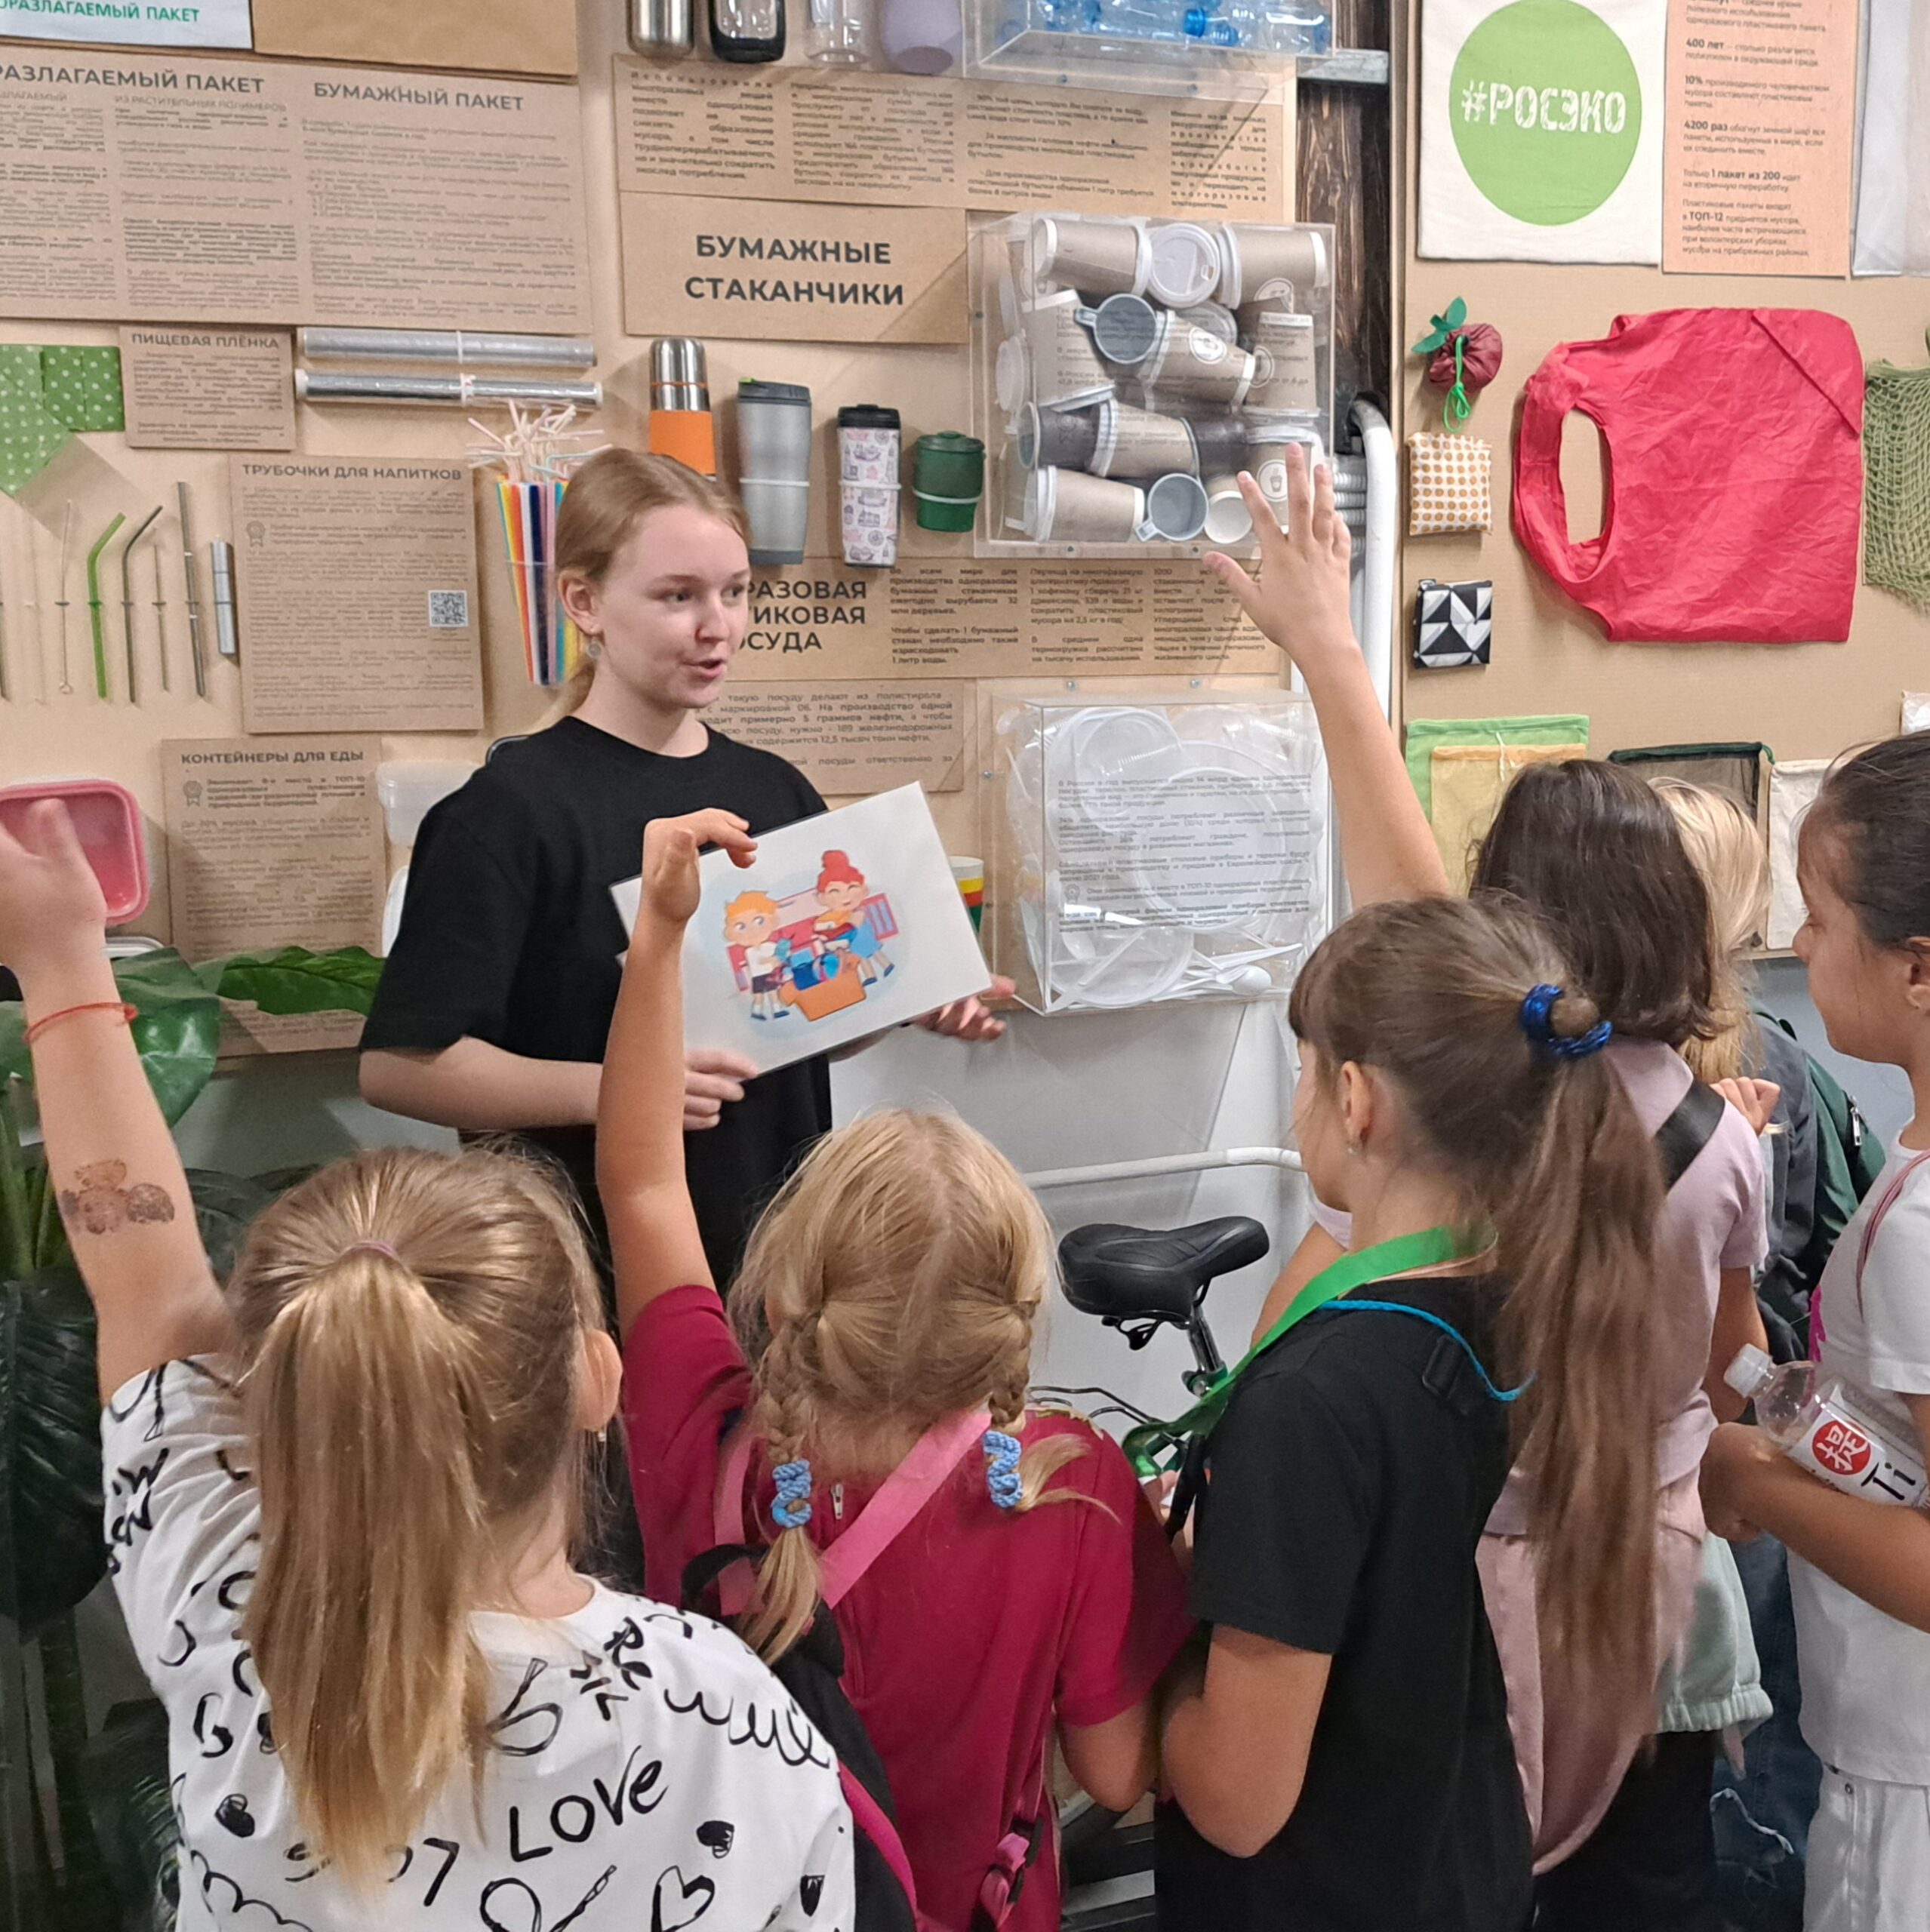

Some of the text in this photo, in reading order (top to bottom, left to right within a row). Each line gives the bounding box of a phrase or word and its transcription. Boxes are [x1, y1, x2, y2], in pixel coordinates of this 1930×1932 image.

[146, 8, 200, 22] ПАКЕТ
[1686, 39, 1704, 48] 400
[0, 64, 264, 94] АЗЛАГАЕМЫЙ ПАКЕТ
[1685, 75, 1703, 85] 10%
[314, 82, 524, 111] БУМАЖНЫЙ ПАКЕТ
[1461, 79, 1627, 135] #РОСЭКО
[1684, 120, 1708, 129] 4200
[1763, 171, 1780, 180] 200
[1689, 213, 1723, 221] ТОП-12
[696, 235, 891, 265] БУМАЖНЫЕ
[685, 277, 904, 305] СТАКАНЧИКИ
[132, 334, 211, 347] ПИЩЕВАЯ
[243, 463, 462, 481] ТРУБОЧКИ ДЛЯ НАПИТКОВ
[749, 606, 866, 625] ИКОВАЯ
[739, 632, 823, 654] СУДА
[181, 750, 363, 764] КОНТЕЙНЕРЫ ДЛЯ ЕДЫ
